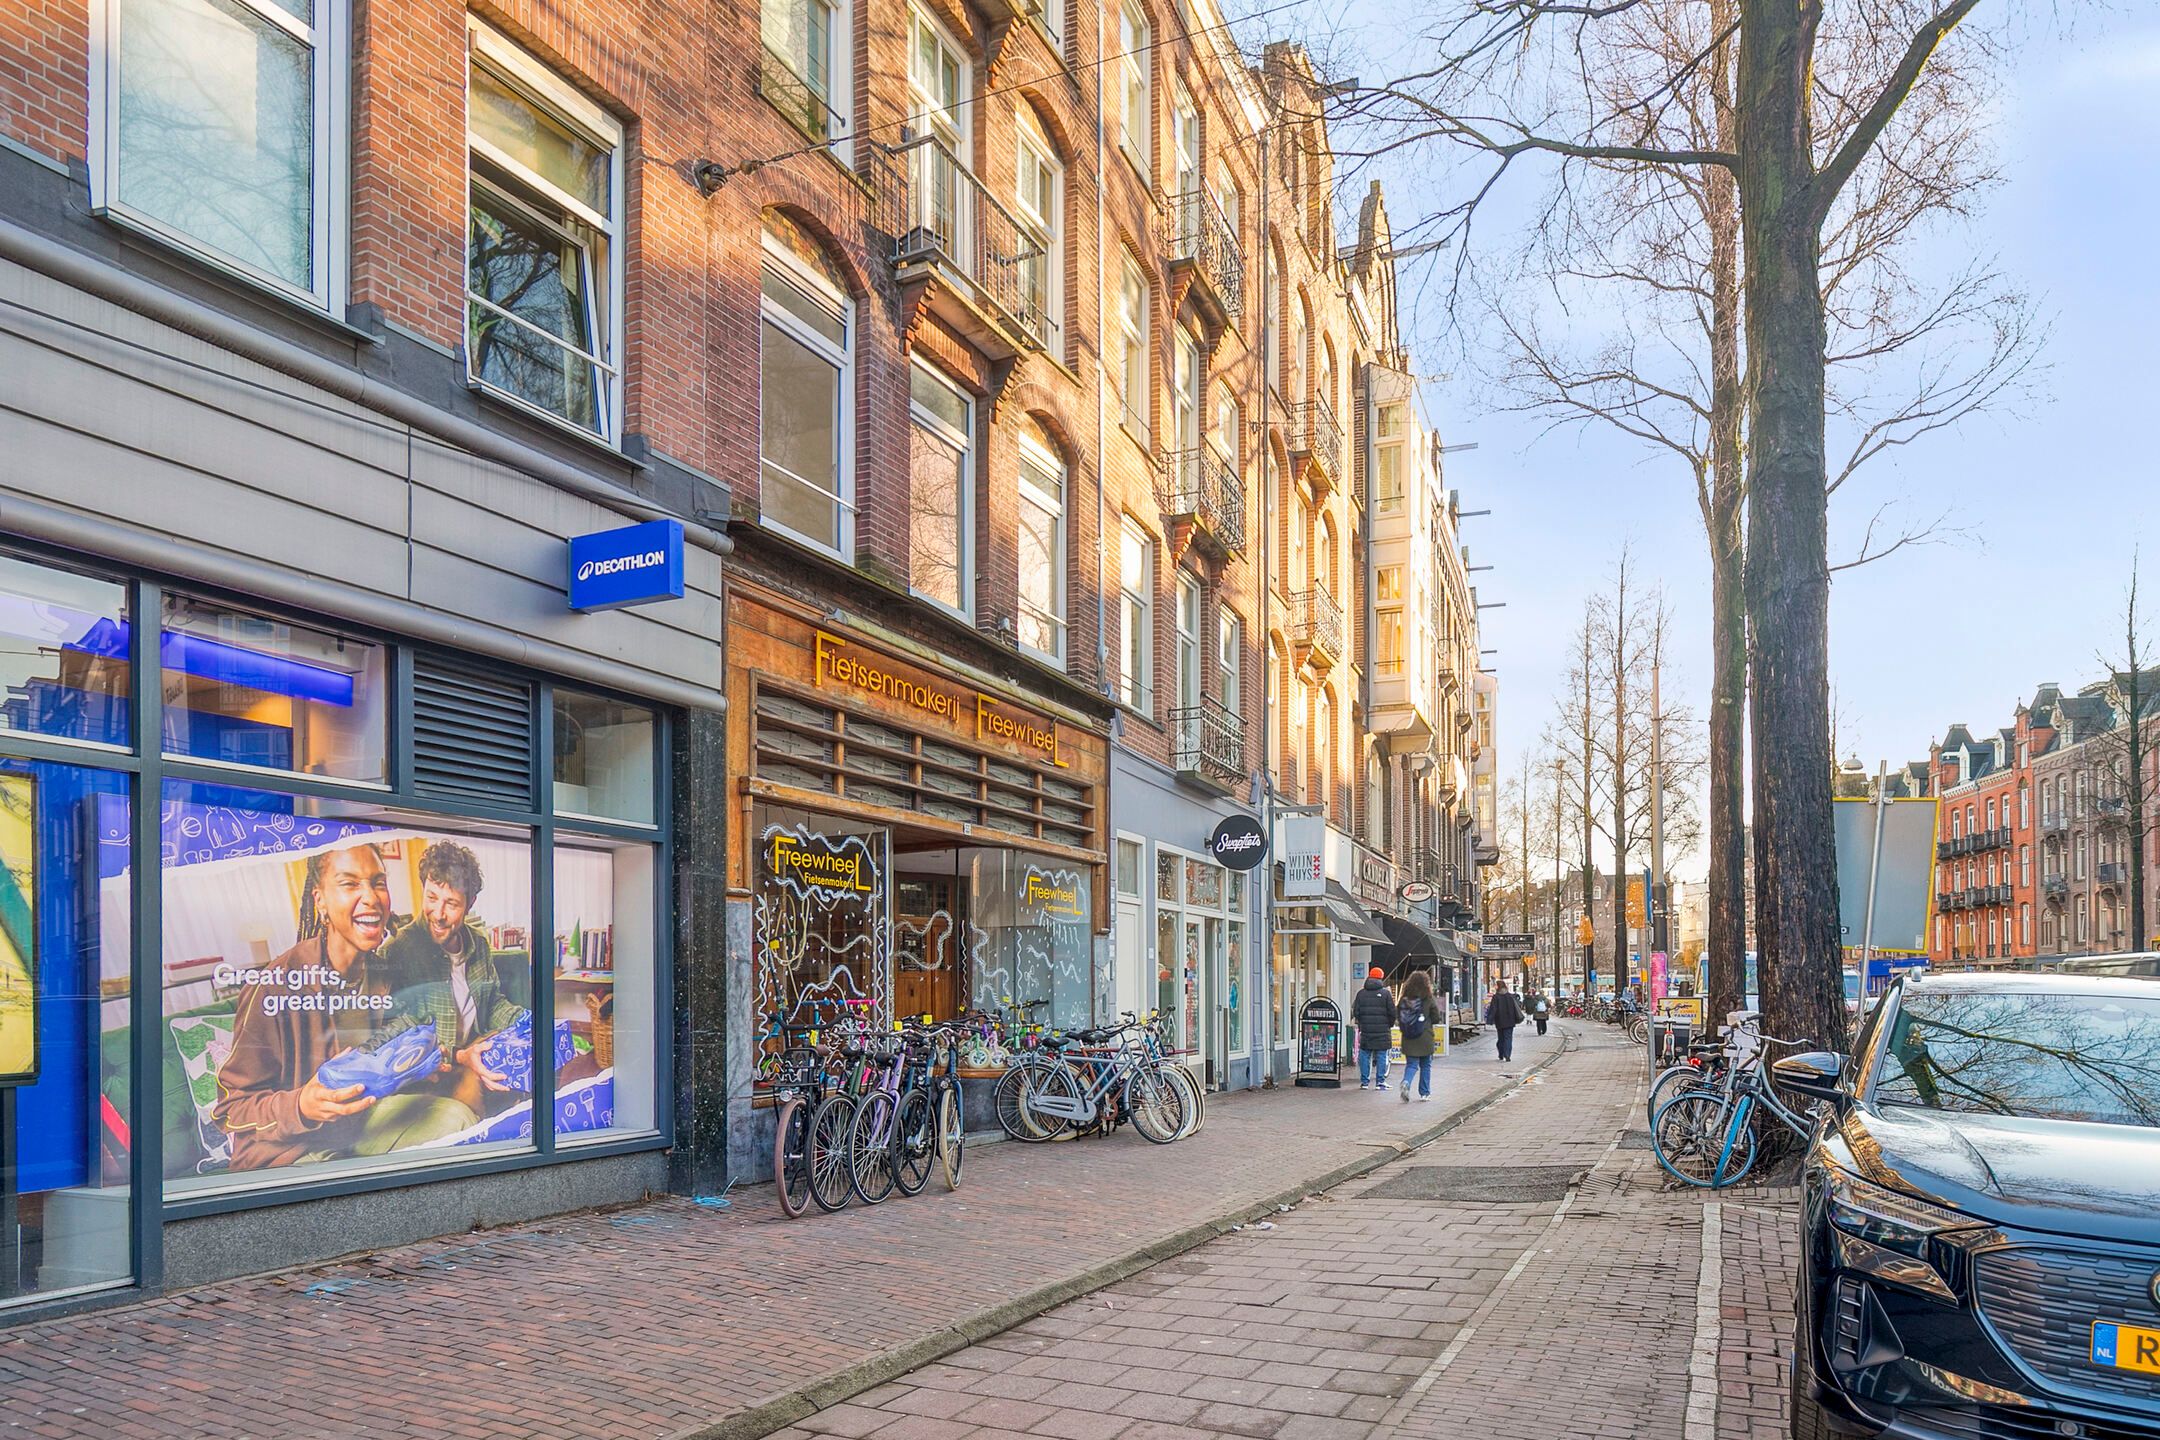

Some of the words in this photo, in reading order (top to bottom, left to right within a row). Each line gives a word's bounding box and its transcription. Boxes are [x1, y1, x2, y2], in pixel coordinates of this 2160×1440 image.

[595, 551, 664, 576] DECATHLON
[815, 629, 960, 723] Fietsenmakerij
[1216, 832, 1261, 852] Swapfiets
[1288, 855, 1312, 868] WIJN
[804, 872, 854, 891] Fietsenmakerij
[1289, 868, 1312, 881] HUYS
[213, 963, 284, 986] Great
[287, 965, 346, 990] gifts,
[263, 991, 325, 1016] great
[329, 990, 393, 1015] prices
[2097, 1347, 2114, 1359] NL
